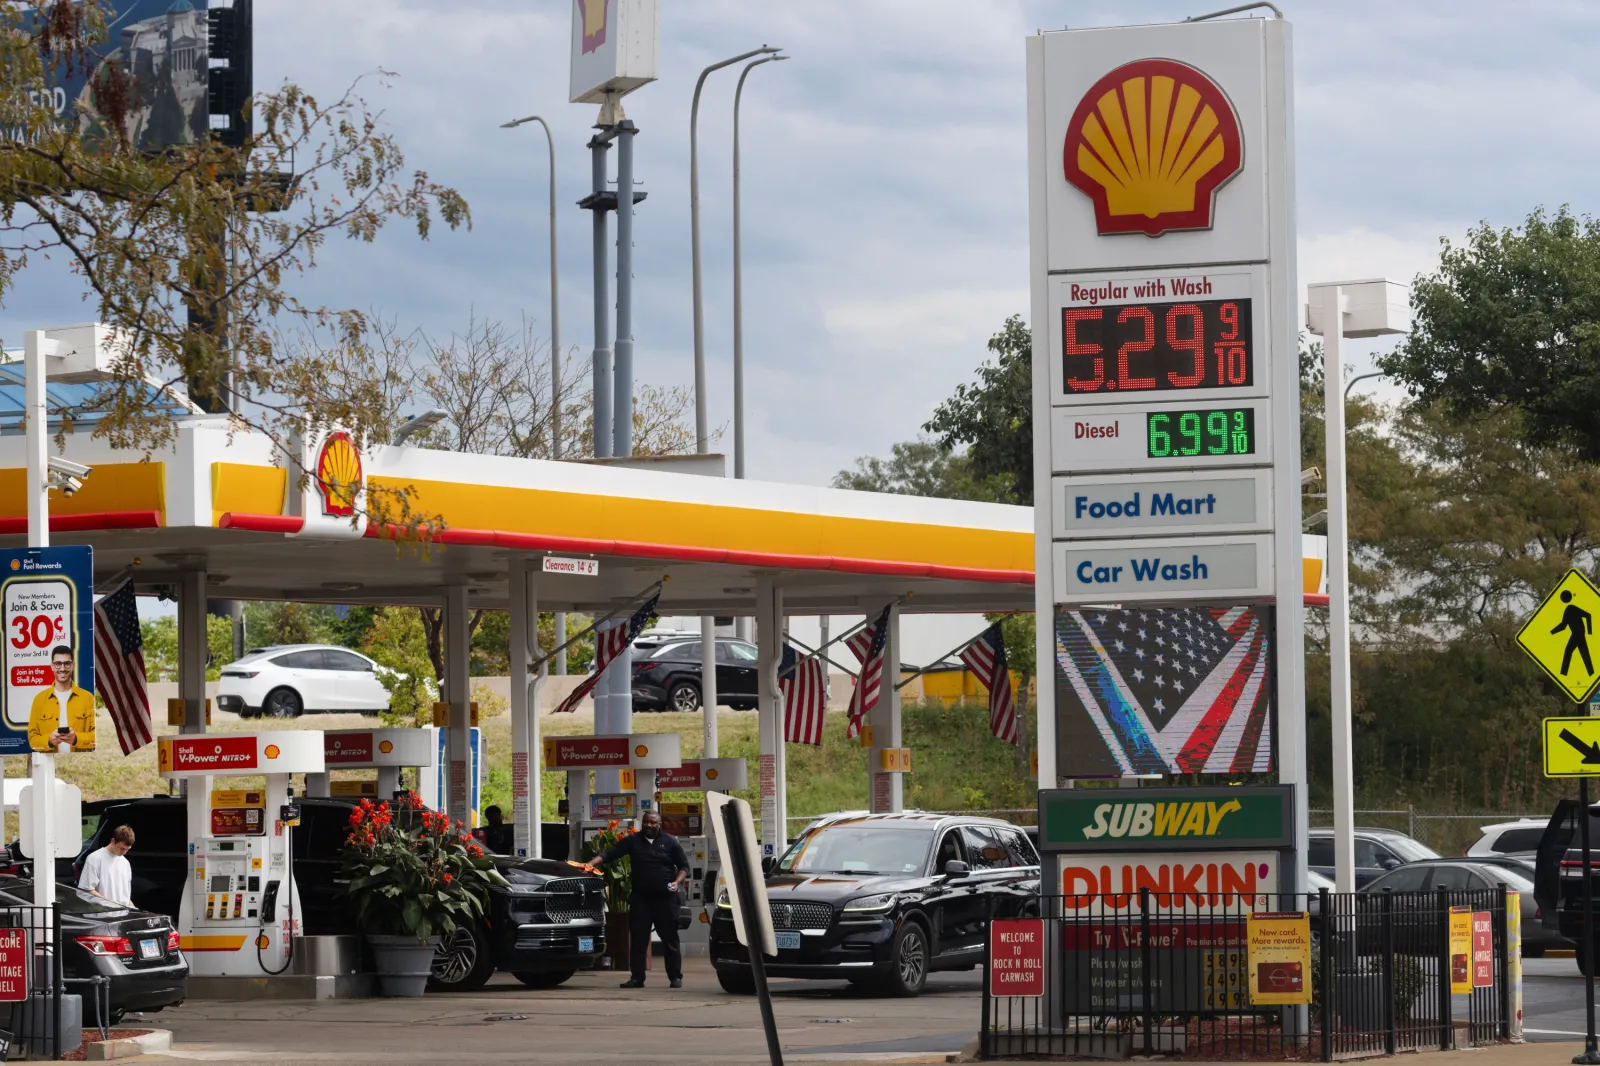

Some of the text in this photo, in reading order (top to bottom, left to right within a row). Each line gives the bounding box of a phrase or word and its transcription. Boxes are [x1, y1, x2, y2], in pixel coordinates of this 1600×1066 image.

[1071, 276, 1212, 305] Regular with Wash
[1065, 304, 1205, 391] 5.29
[1074, 420, 1119, 440] Diesel
[1149, 411, 1228, 457] 6.99
[1075, 492, 1216, 519] Food Mart
[545, 559, 575, 571] Clearance
[1077, 555, 1208, 584] Car Wash
[10, 601, 64, 612] Join & Save
[34, 667, 45, 675] the
[16, 676, 44, 685] Shell App
[178, 746, 194, 754] Shell
[160, 750, 168, 764] 2
[178, 754, 219, 763] V-Power
[889, 753, 895, 766] 9
[622, 772, 630, 783] 11
[1082, 797, 1243, 840] SUBWAY
[1063, 862, 1269, 910] DUNKIN'
[1000, 932, 1035, 943] WELCOME
[1259, 927, 1299, 937] New card.
[1251, 936, 1307, 945] More rewards.
[1013, 946, 1022, 955] TO
[993, 958, 1042, 969] ROCK N ROLL
[1000, 972, 1035, 983] CARWASH
